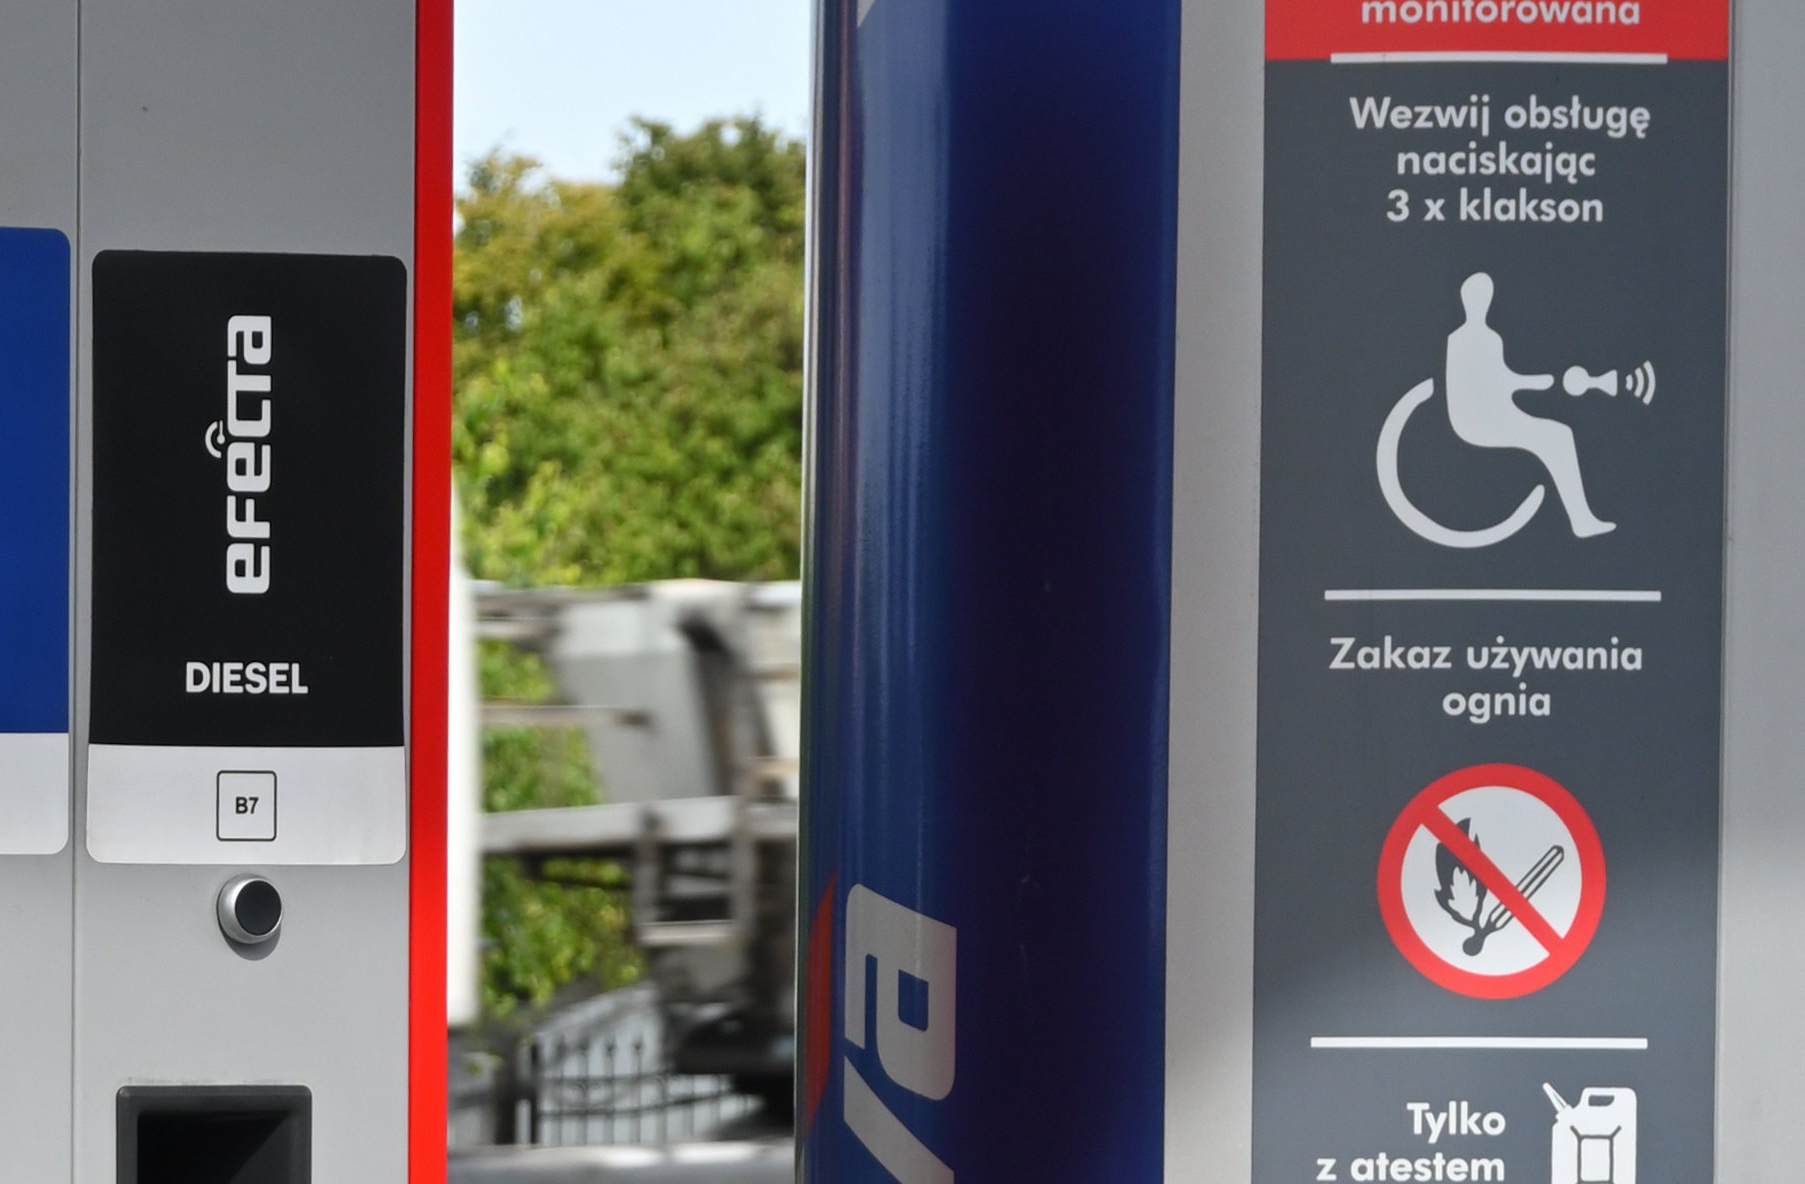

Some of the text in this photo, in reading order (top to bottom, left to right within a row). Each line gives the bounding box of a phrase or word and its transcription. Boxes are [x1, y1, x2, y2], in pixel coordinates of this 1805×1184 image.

[1349, 94, 1651, 138] Wezwij obsługę
[1396, 141, 1596, 184] naciskając
[1387, 188, 1603, 222] 3 x klakson
[1328, 635, 1643, 677] Zakaz używania
[185, 661, 309, 696] DIESEL
[1442, 681, 1551, 724] ognia
[234, 796, 259, 816] B7
[1406, 1101, 1506, 1143] Tylko
[1316, 1151, 1505, 1181] z atestem
